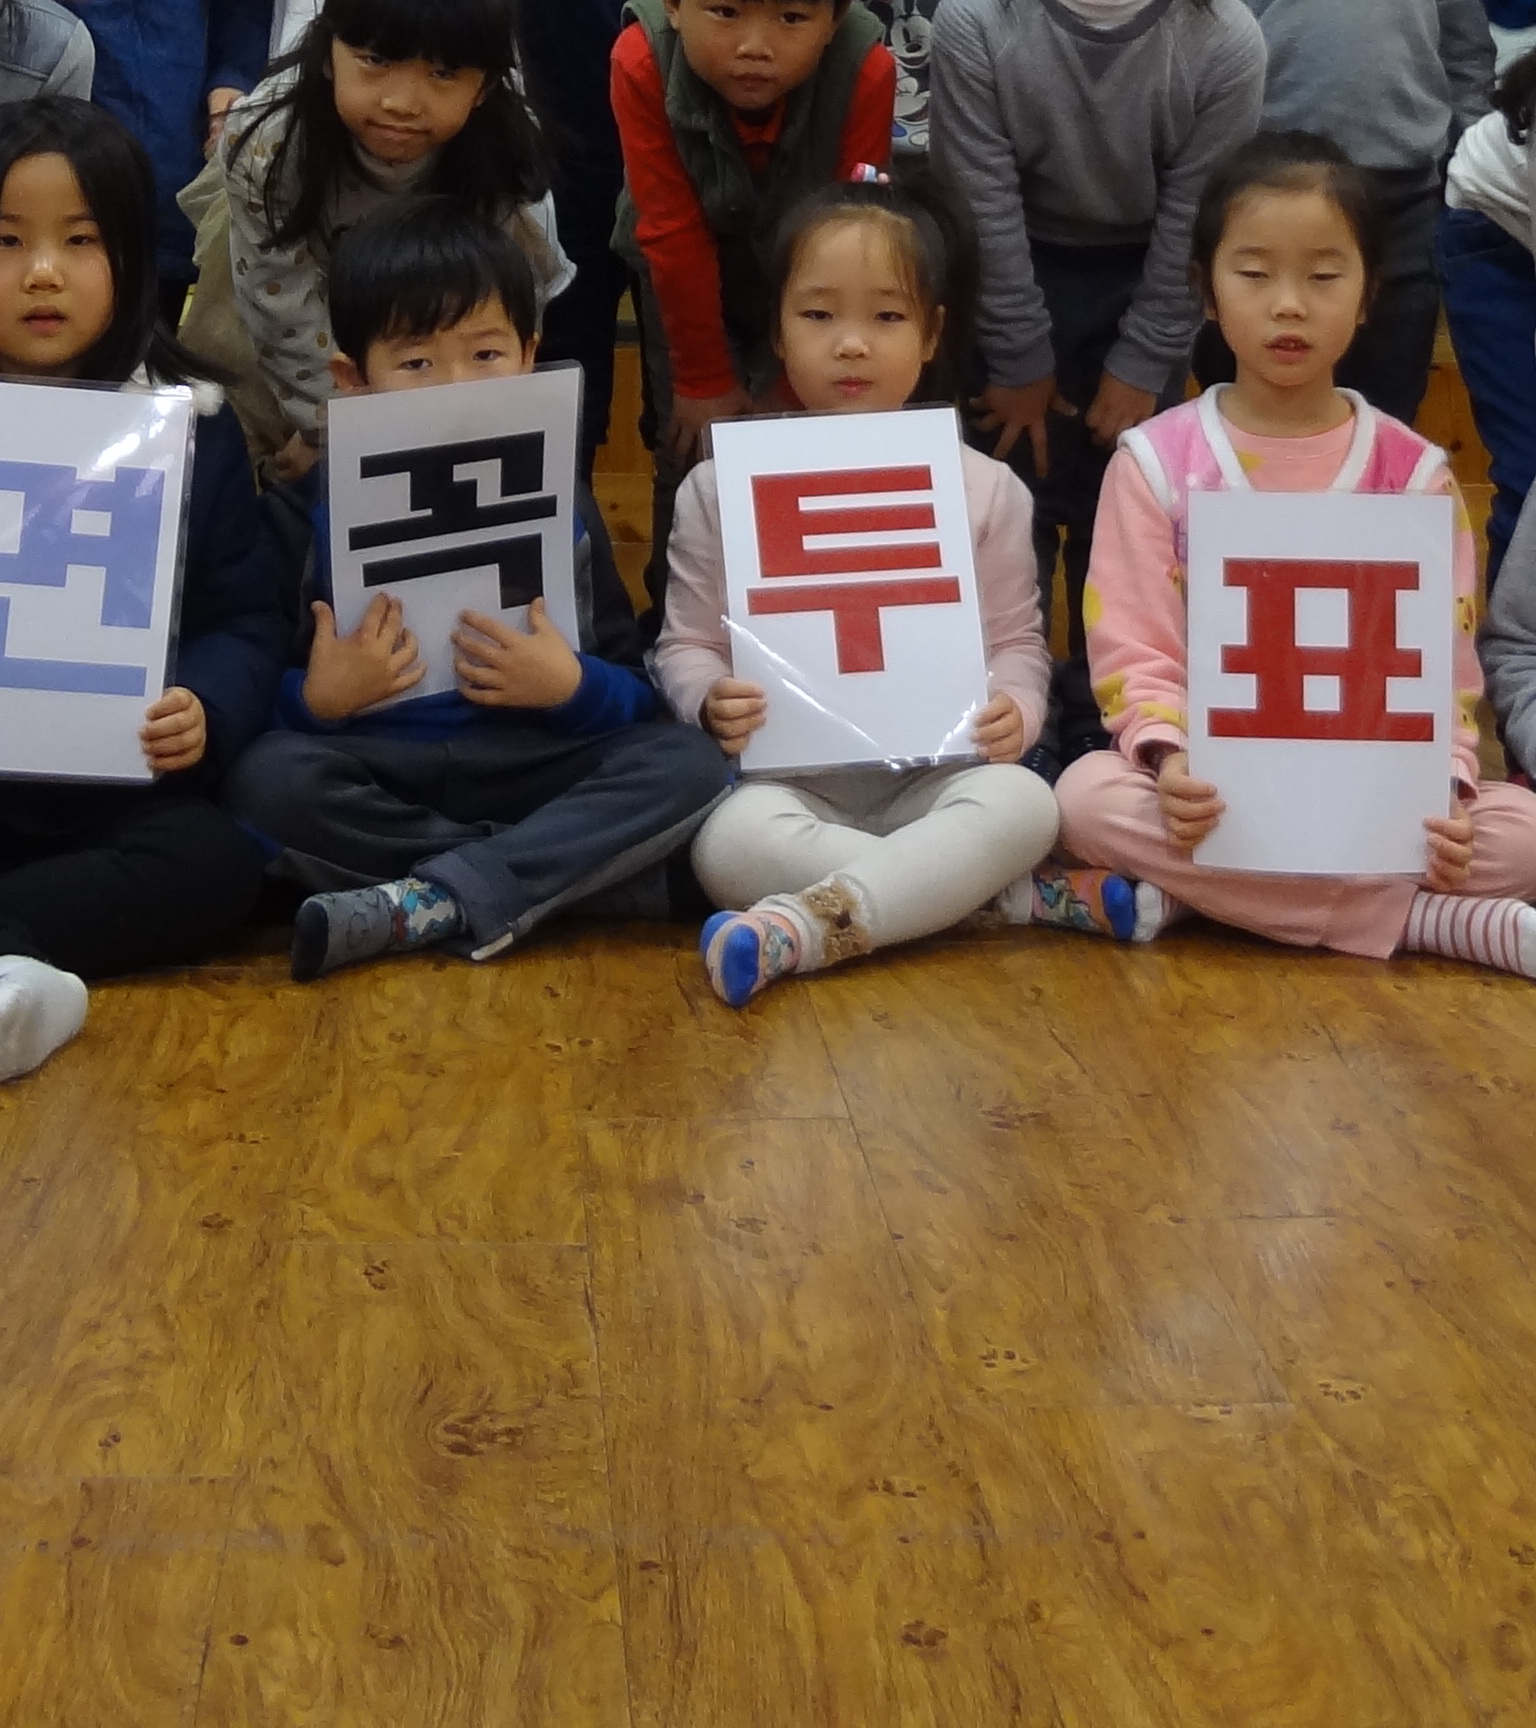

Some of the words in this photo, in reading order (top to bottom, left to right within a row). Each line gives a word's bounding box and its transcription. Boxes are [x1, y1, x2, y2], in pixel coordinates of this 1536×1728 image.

[348, 430, 558, 610] 꼭
[746, 464, 962, 675] 투
[1207, 557, 1435, 742] 표
